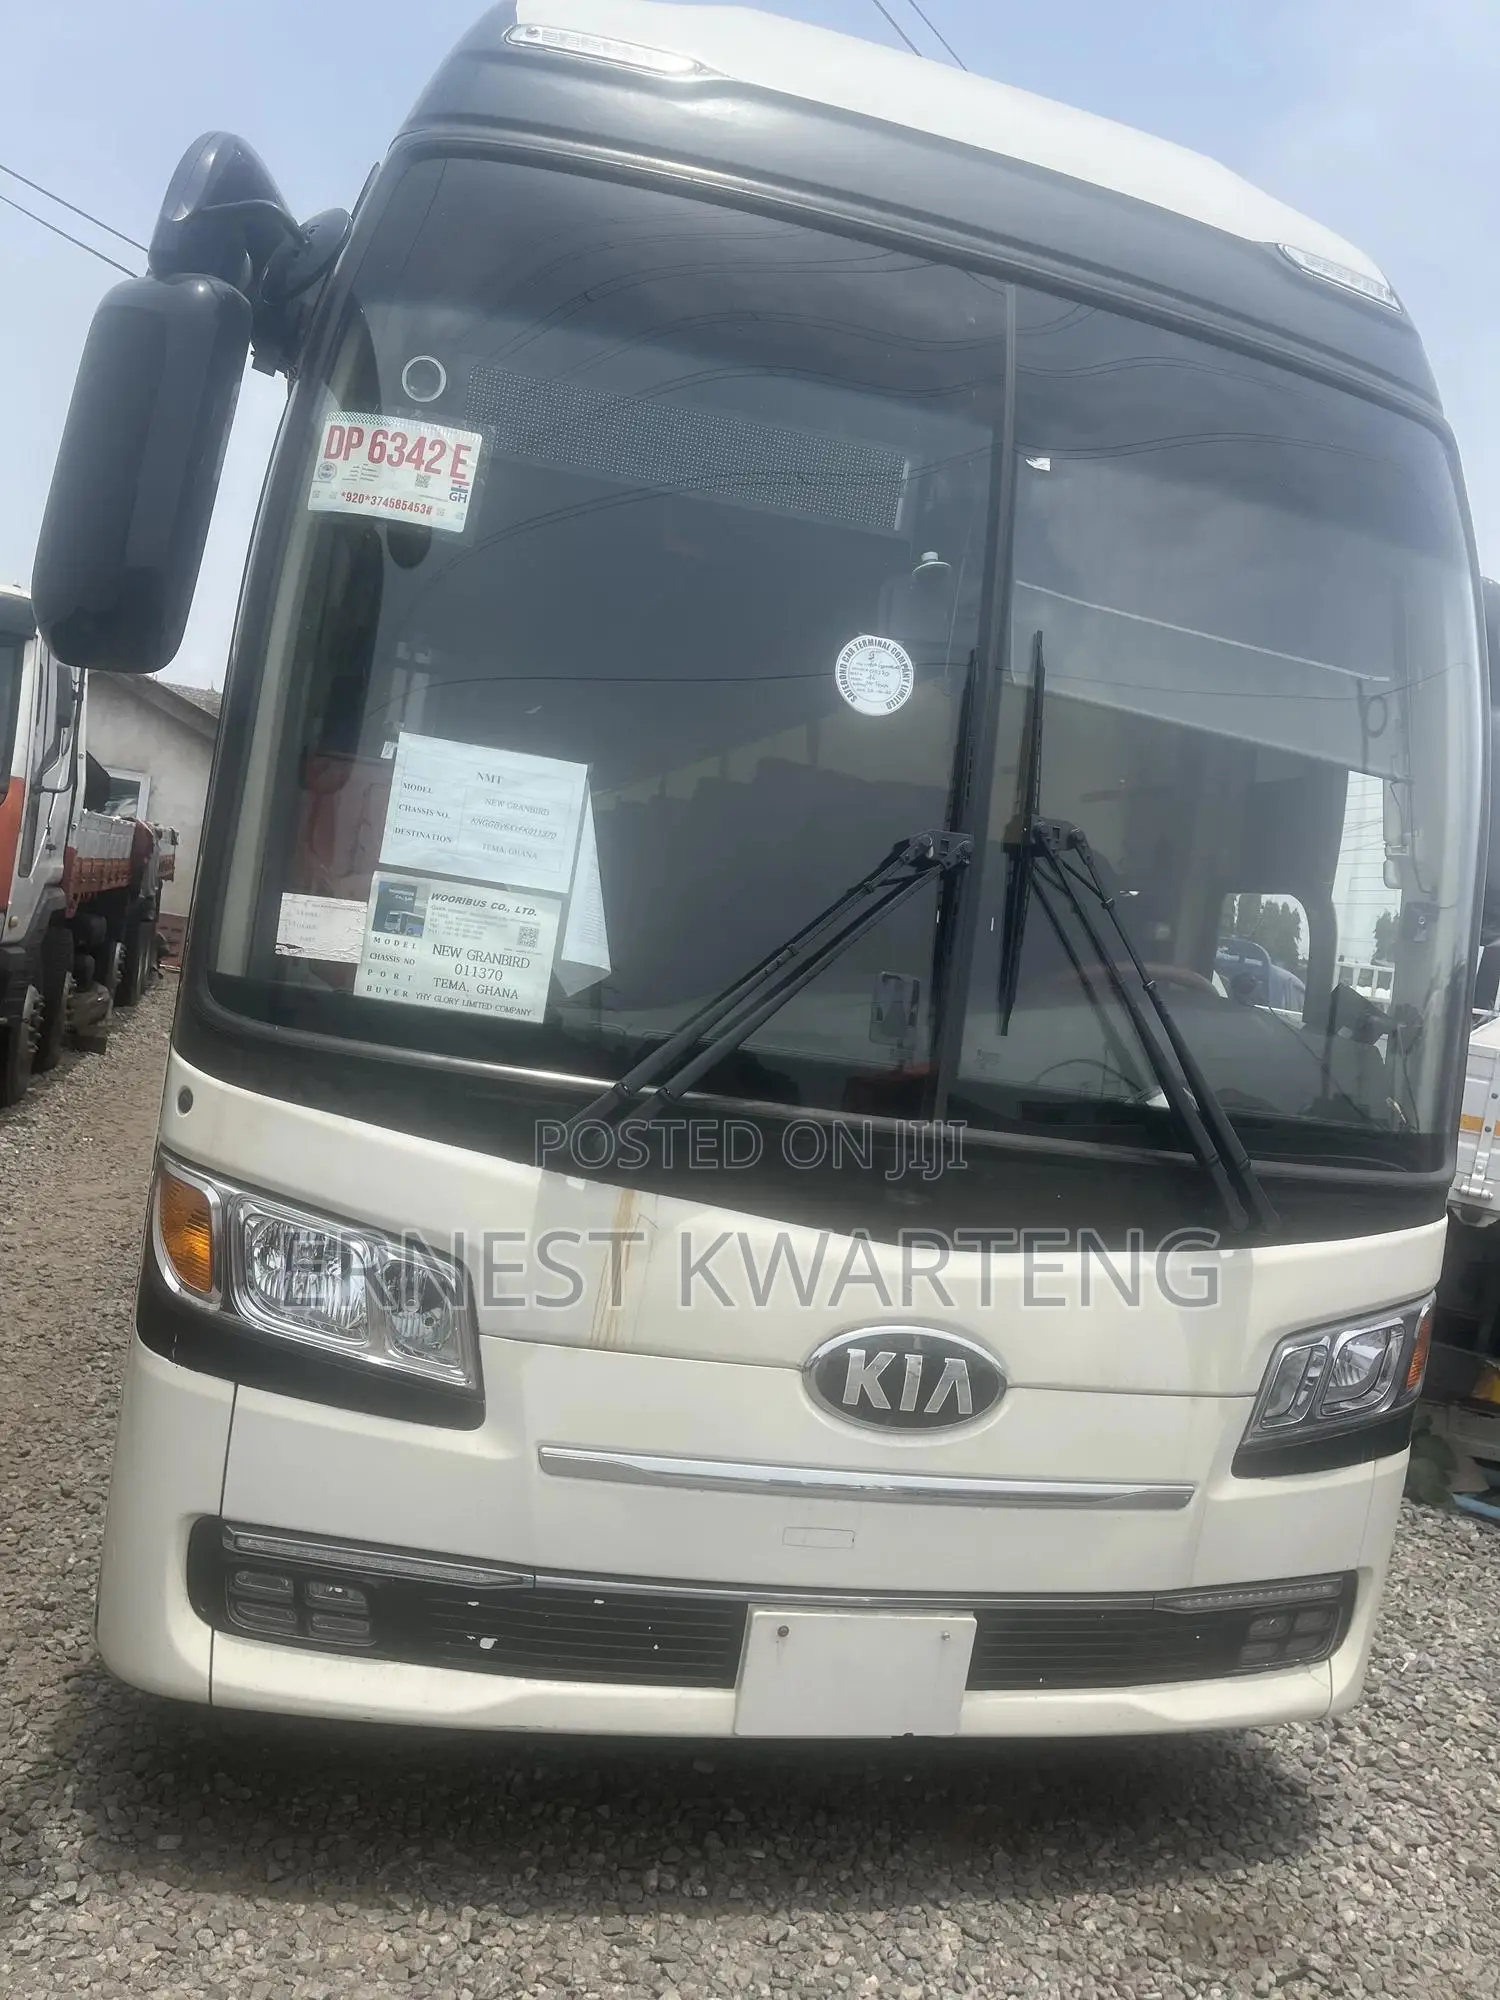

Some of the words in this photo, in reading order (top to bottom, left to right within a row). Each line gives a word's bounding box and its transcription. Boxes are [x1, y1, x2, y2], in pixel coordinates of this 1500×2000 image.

[324, 424, 365, 461] DP
[367, 429, 446, 475] 6342
[450, 443, 472, 480] E
[449, 492, 467, 504] GH
[853, 638, 892, 651] TERMINAL
[841, 647, 856, 663] CAR
[890, 647, 911, 683] COMPANY
[838, 663, 858, 703] SAFEBOND
[885, 683, 909, 710] LIMITED
[476, 771, 504, 785] NMT
[402, 781, 434, 795] MODEL
[398, 803, 434, 818] CHASSIS
[484, 797, 505, 809] NEW
[507, 801, 550, 816] GRANBIRD
[394, 826, 453, 844] DESTINATION
[508, 846, 538, 860] GHANA
[430, 892, 487, 908] WOORIBUS
[514, 905, 537, 917] LTD.
[369, 952, 401, 964] CHASSIS
[432, 943, 463, 959] NEW
[466, 948, 531, 970] GRANBIRD
[454, 963, 503, 982] 011370
[475, 983, 519, 1000] GHANA
[415, 991, 431, 1002] YHY
[433, 994, 459, 1006] GLORY
[461, 998, 493, 1011] LIMITED
[494, 1003, 532, 1017] COMPANY
[843, 1348, 974, 1414] KIA
